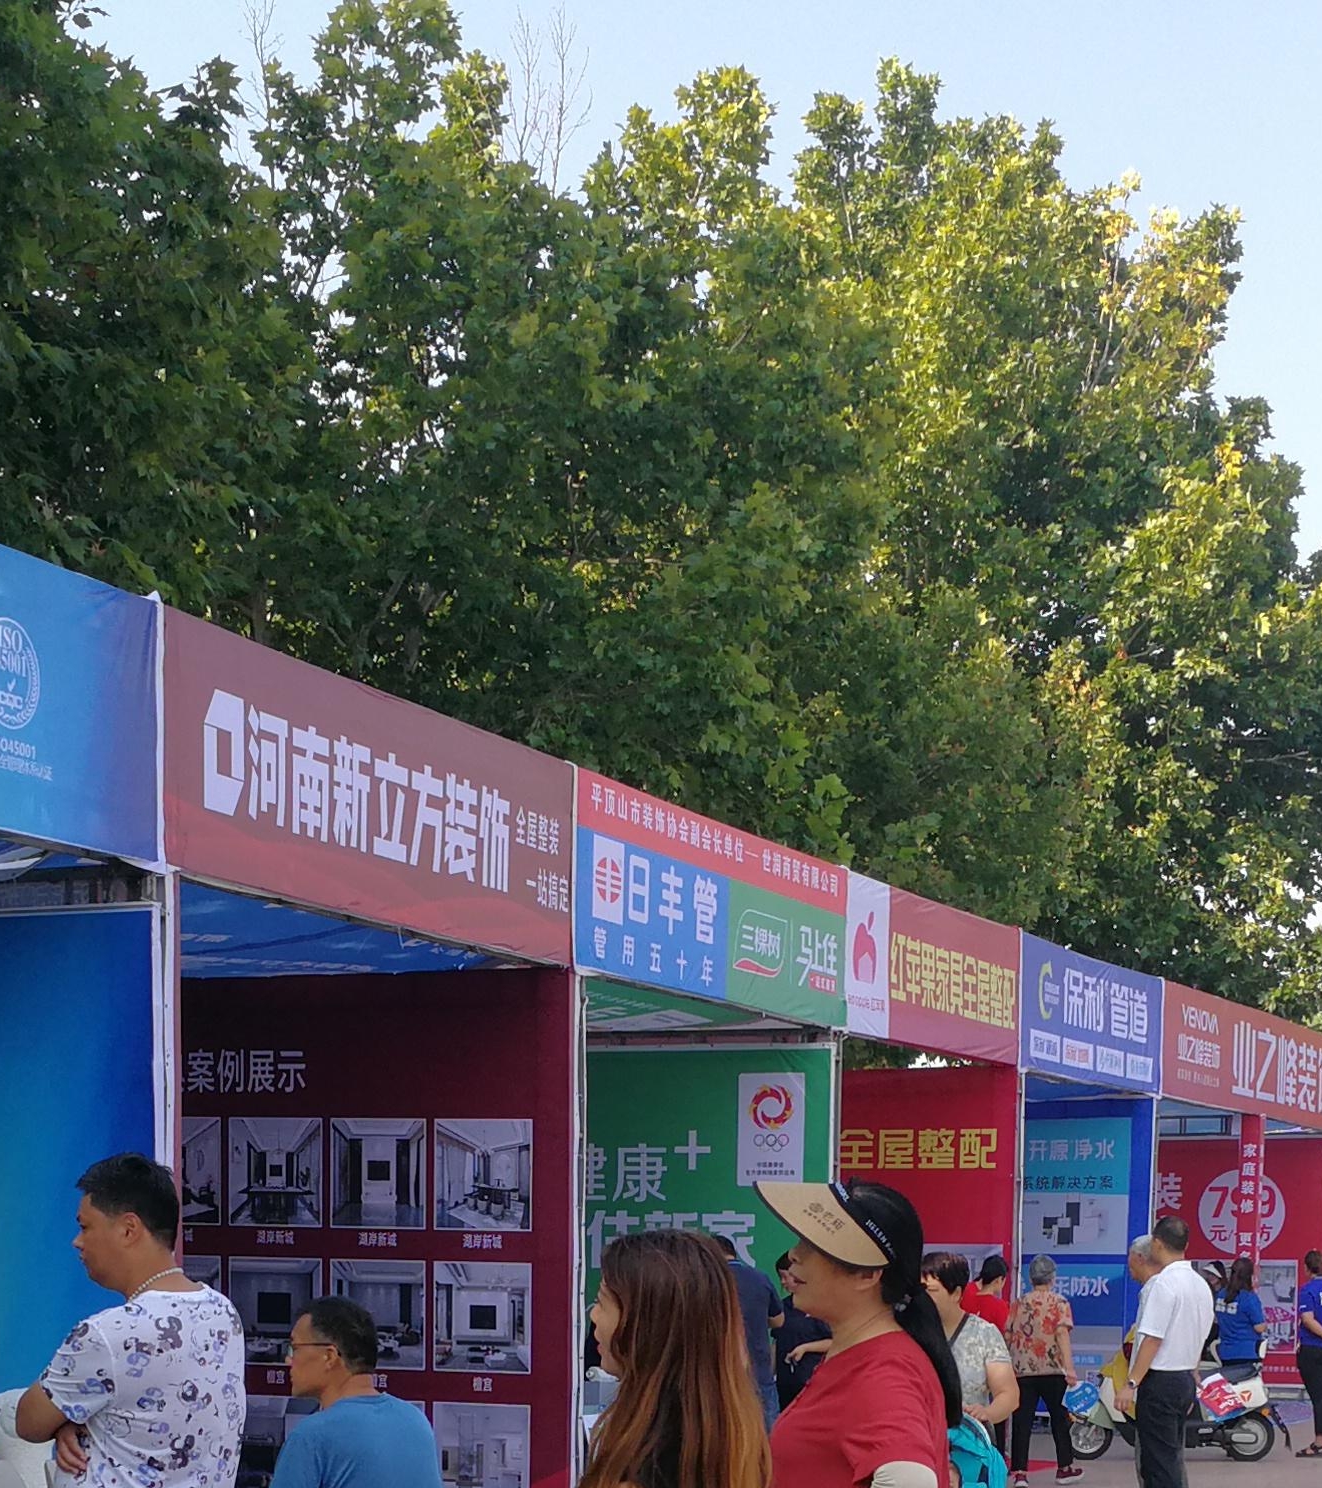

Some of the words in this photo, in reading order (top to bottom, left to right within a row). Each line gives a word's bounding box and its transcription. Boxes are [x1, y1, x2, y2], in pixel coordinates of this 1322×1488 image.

[248, 703, 511, 893] 河南新立方装饰
[515, 806, 559, 856] 全屋整装
[525, 868, 569, 914] 一站搞定
[628, 853, 718, 945] 日丰管
[592, 925, 714, 987] 管用五十年
[740, 925, 781, 960] 三棵树
[796, 925, 838, 986] 马上住
[890, 931, 1016, 1031] 红苹果家具全屋整配
[181, 1048, 307, 1095] 案例展示
[1177, 1033, 1221, 1070] 业之峰装饰
[839, 1128, 998, 1169] 全屋整配
[1239, 1143, 1258, 1215] 家庭装修
